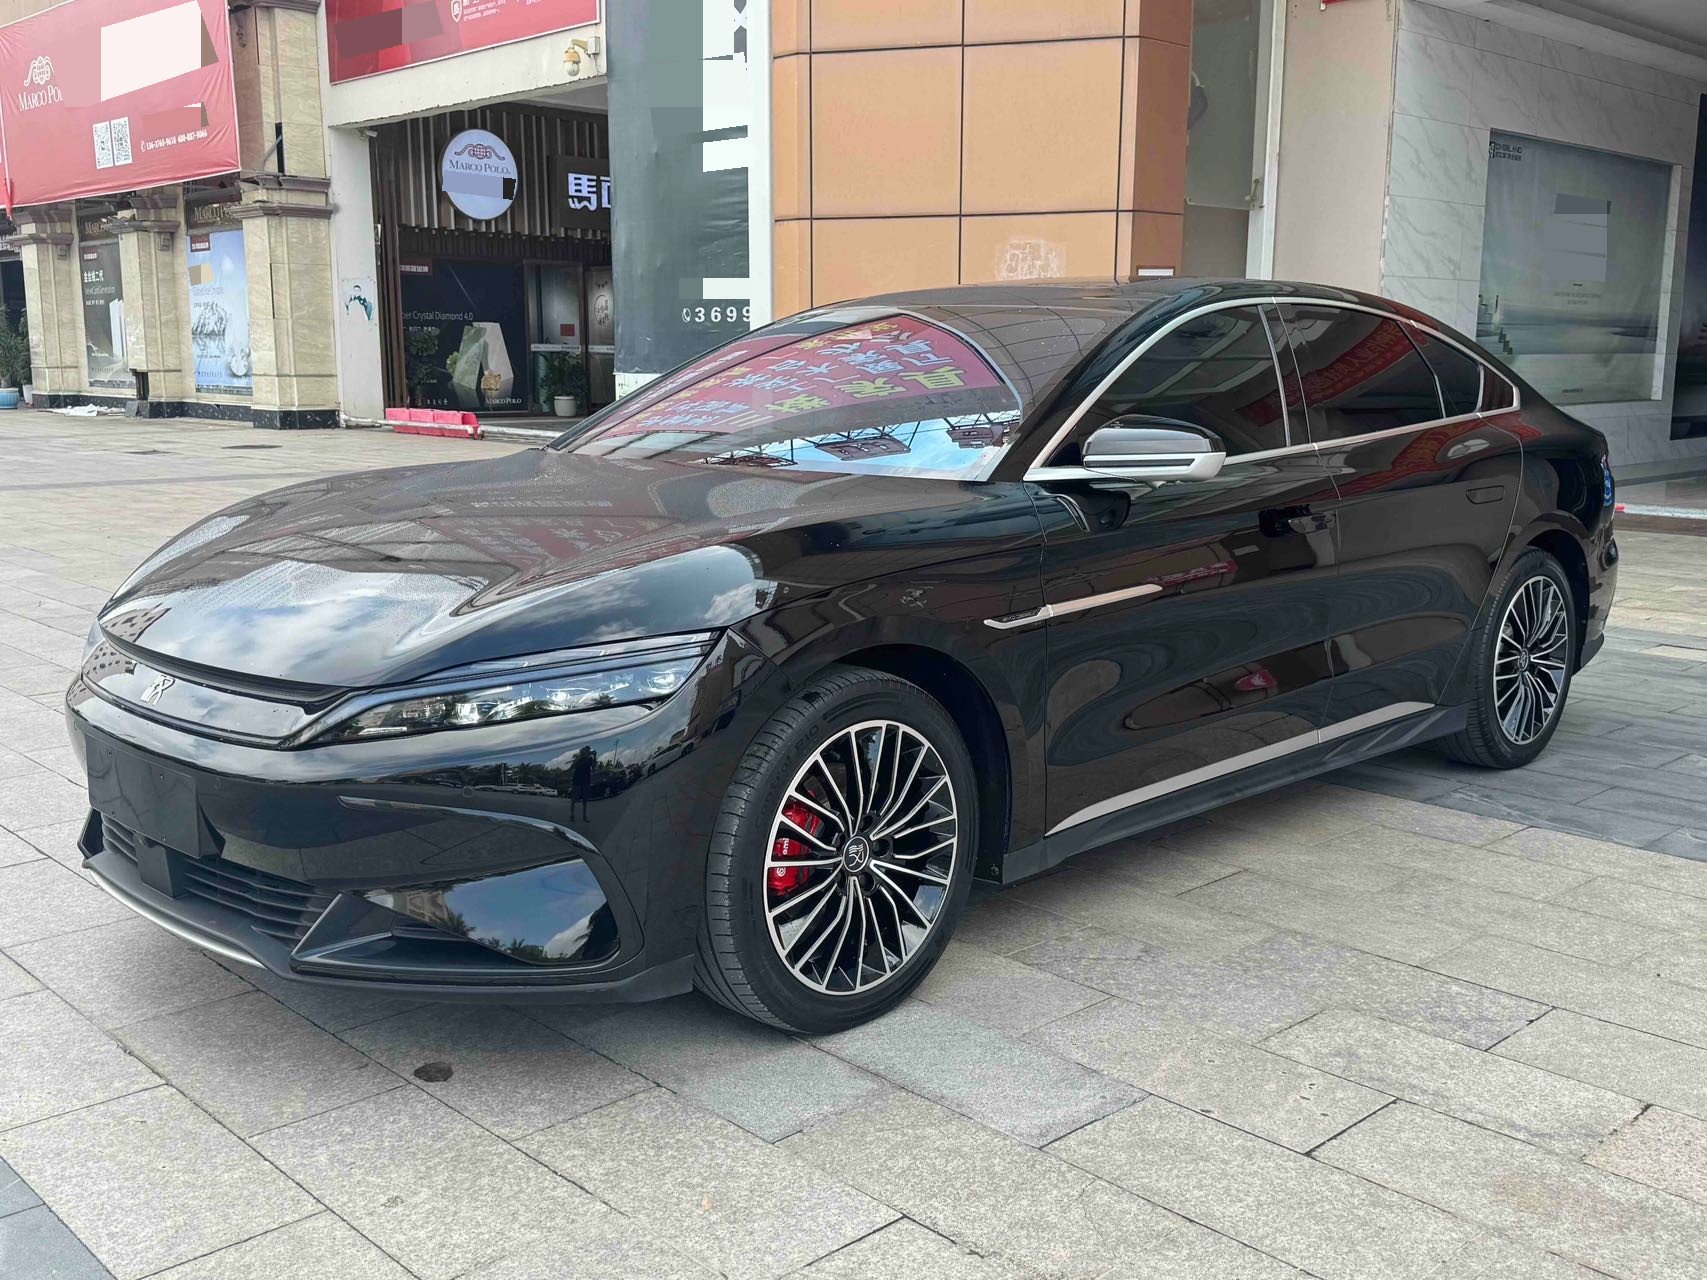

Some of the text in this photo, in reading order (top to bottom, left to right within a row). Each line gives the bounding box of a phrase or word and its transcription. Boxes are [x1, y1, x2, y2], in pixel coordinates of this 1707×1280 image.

[18, 85, 63, 111] MARCO POL
[449, 159, 509, 174] MARCO POLO
[413, 311, 434, 321] Crystal
[435, 312, 463, 320] Diamond
[695, 306, 750, 323] 3699
